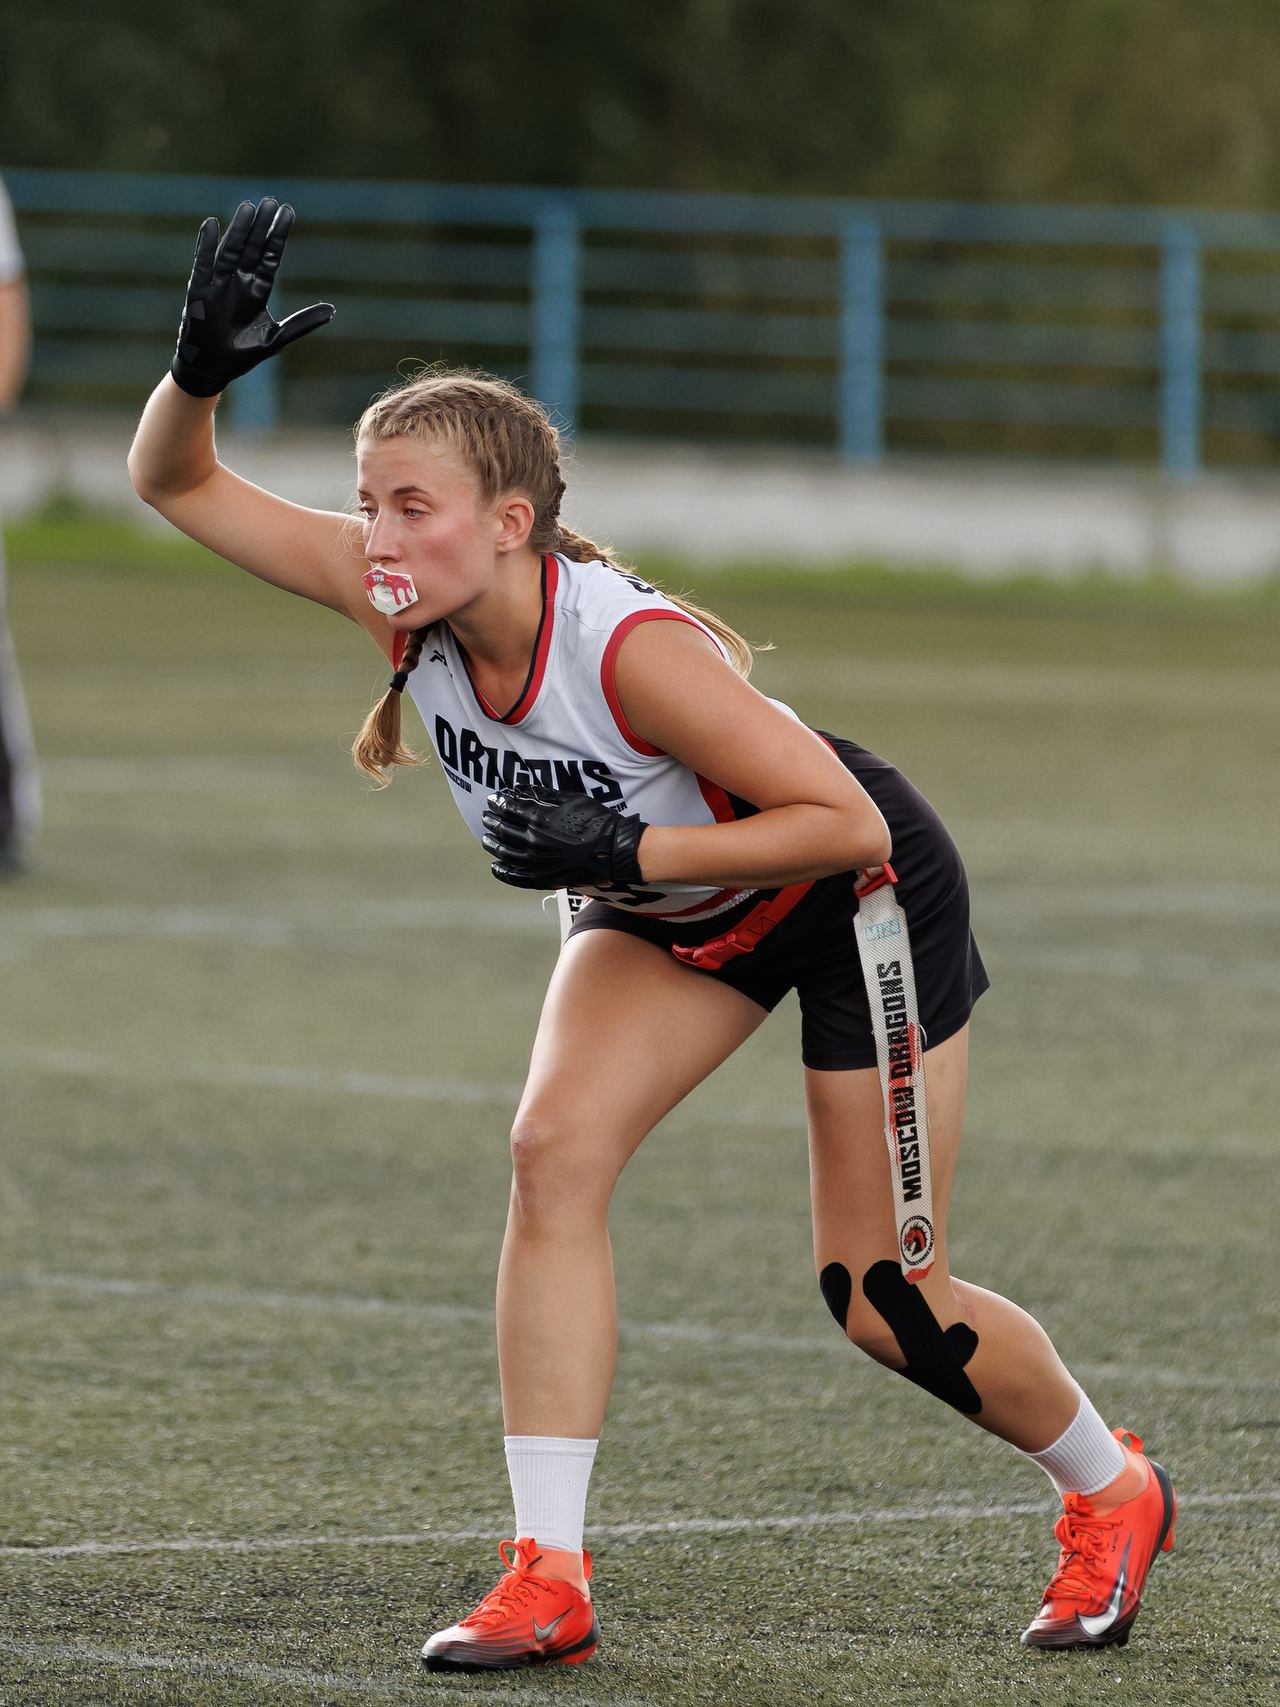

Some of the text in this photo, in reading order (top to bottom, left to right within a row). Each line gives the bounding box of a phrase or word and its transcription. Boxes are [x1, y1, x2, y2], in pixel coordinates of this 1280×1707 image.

[435, 713, 624, 803] DRAGONS
[876, 960, 913, 1080] DRAGONS
[892, 1085, 923, 1203] MOSCOW
